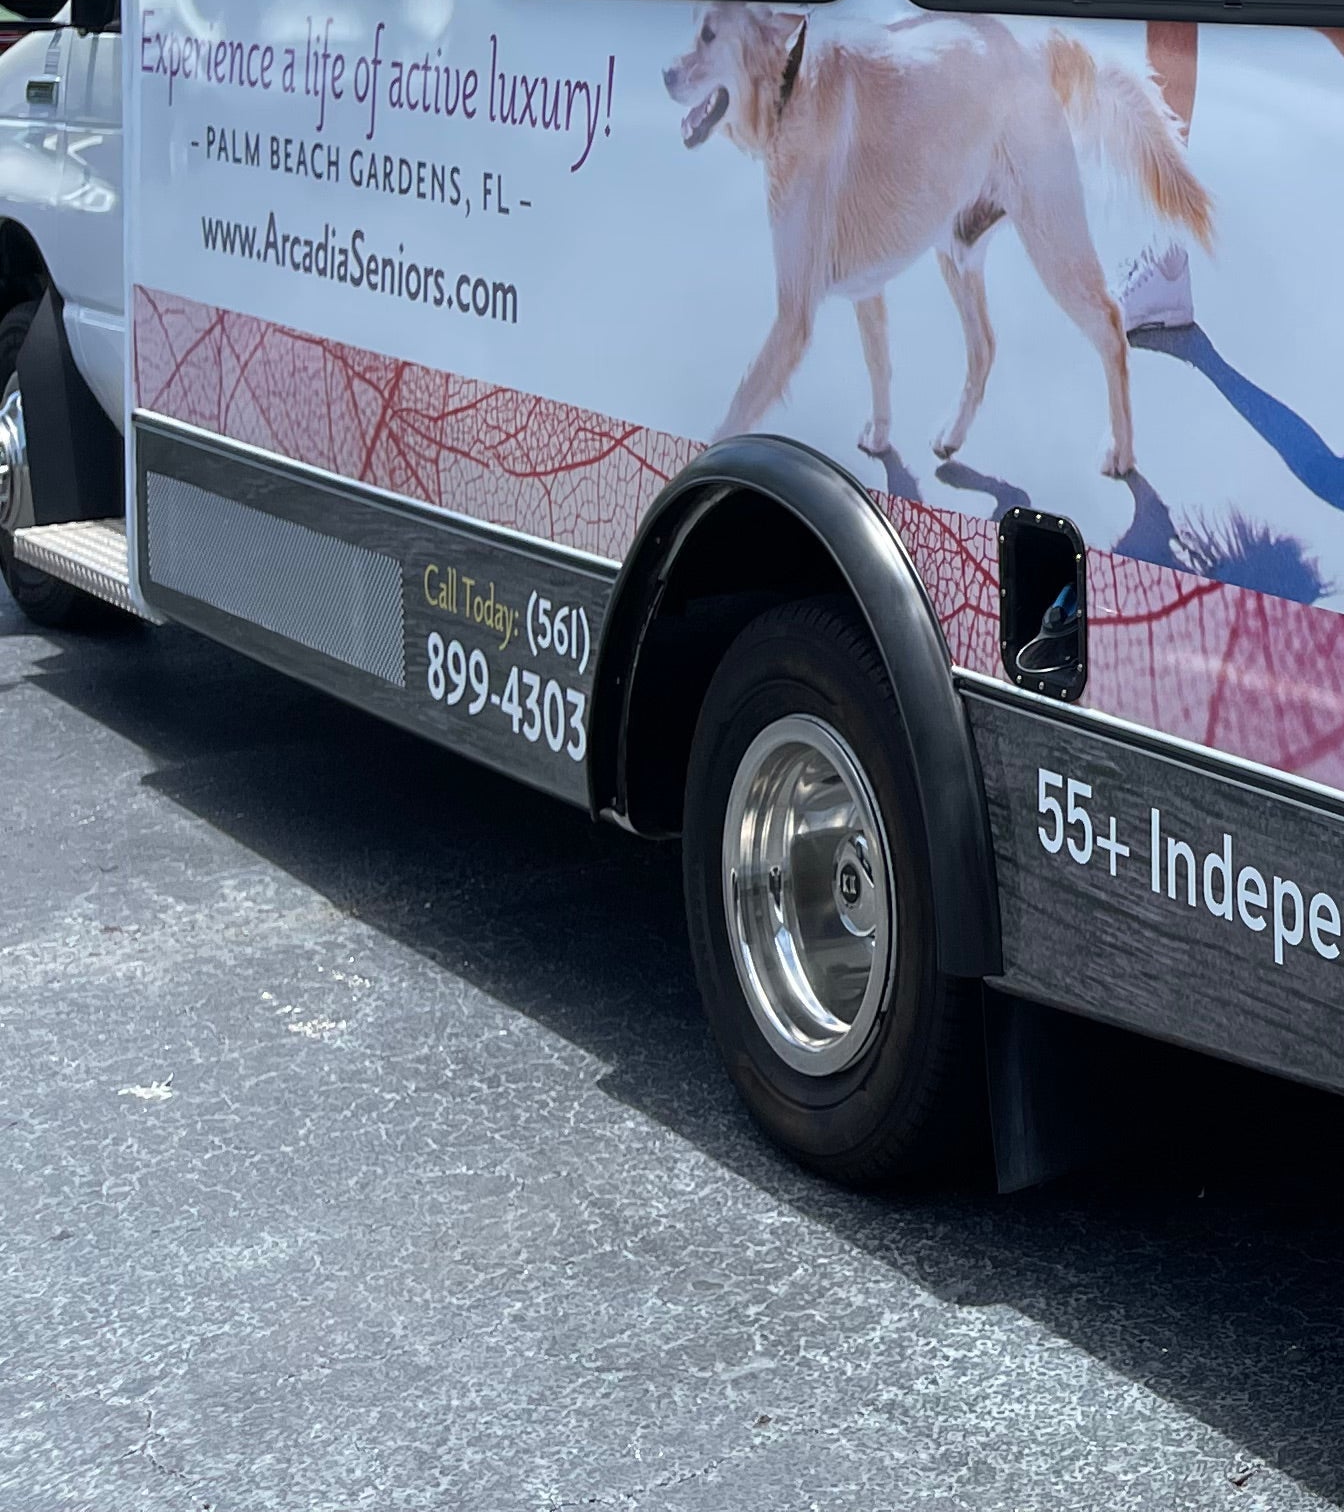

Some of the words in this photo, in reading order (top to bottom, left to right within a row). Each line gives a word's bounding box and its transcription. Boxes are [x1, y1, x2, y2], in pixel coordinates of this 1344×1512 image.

[142, 10, 274, 107] Experience
[283, 47, 296, 93] a
[305, 16, 344, 132] life
[354, 22, 386, 140] of
[389, 48, 478, 120] active
[489, 34, 616, 173] luxury!
[206, 125, 262, 169] PALM
[270, 135, 341, 183] BEACH
[350, 150, 472, 218] GARDENS,
[482, 172, 510, 216] FL
[202, 212, 518, 324] www.ArcadiaSeniors.com
[424, 564, 457, 613] Call
[462, 576, 519, 651] Today:
[526, 589, 591, 675] (561)
[428, 631, 588, 762] 899-4303
[1035, 767, 1130, 879] 55+
